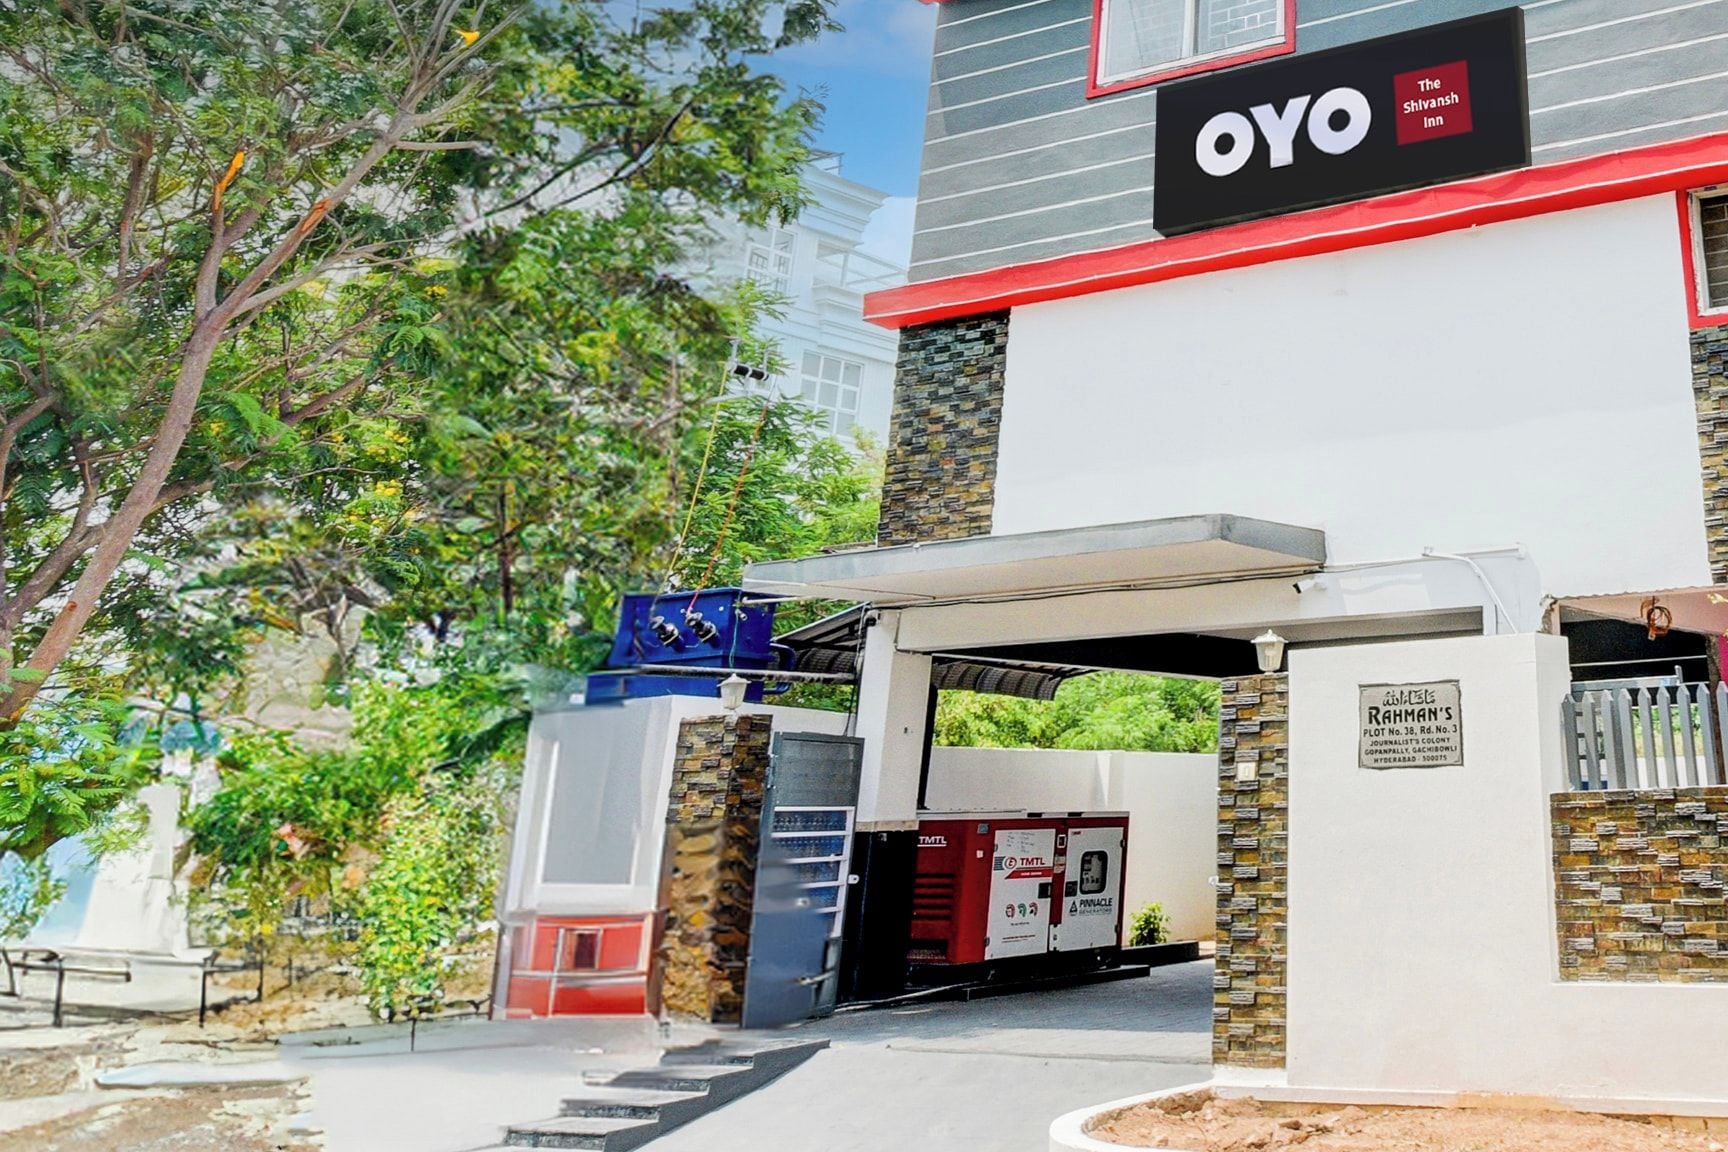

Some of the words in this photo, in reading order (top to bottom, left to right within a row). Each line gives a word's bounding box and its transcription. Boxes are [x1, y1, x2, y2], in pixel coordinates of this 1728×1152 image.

[1418, 79, 1441, 92] The
[1403, 92, 1459, 114] Shivansh
[1424, 116, 1444, 129] Inn
[1196, 87, 1371, 177] OYO
[1363, 728, 1385, 737] PLOT
[1388, 728, 1402, 736] No.
[1420, 726, 1434, 734] Rd.
[1436, 726, 1450, 734] No.
[1452, 724, 1458, 733] 3
[1421, 737, 1450, 745] COLONY
[1412, 745, 1457, 754] GACHIBOWLI
[1374, 755, 1416, 764] HYDERABAD
[918, 836, 947, 844] TMTL
[1020, 857, 1045, 866] TMTL
[1080, 898, 1112, 908] PINNACLE
